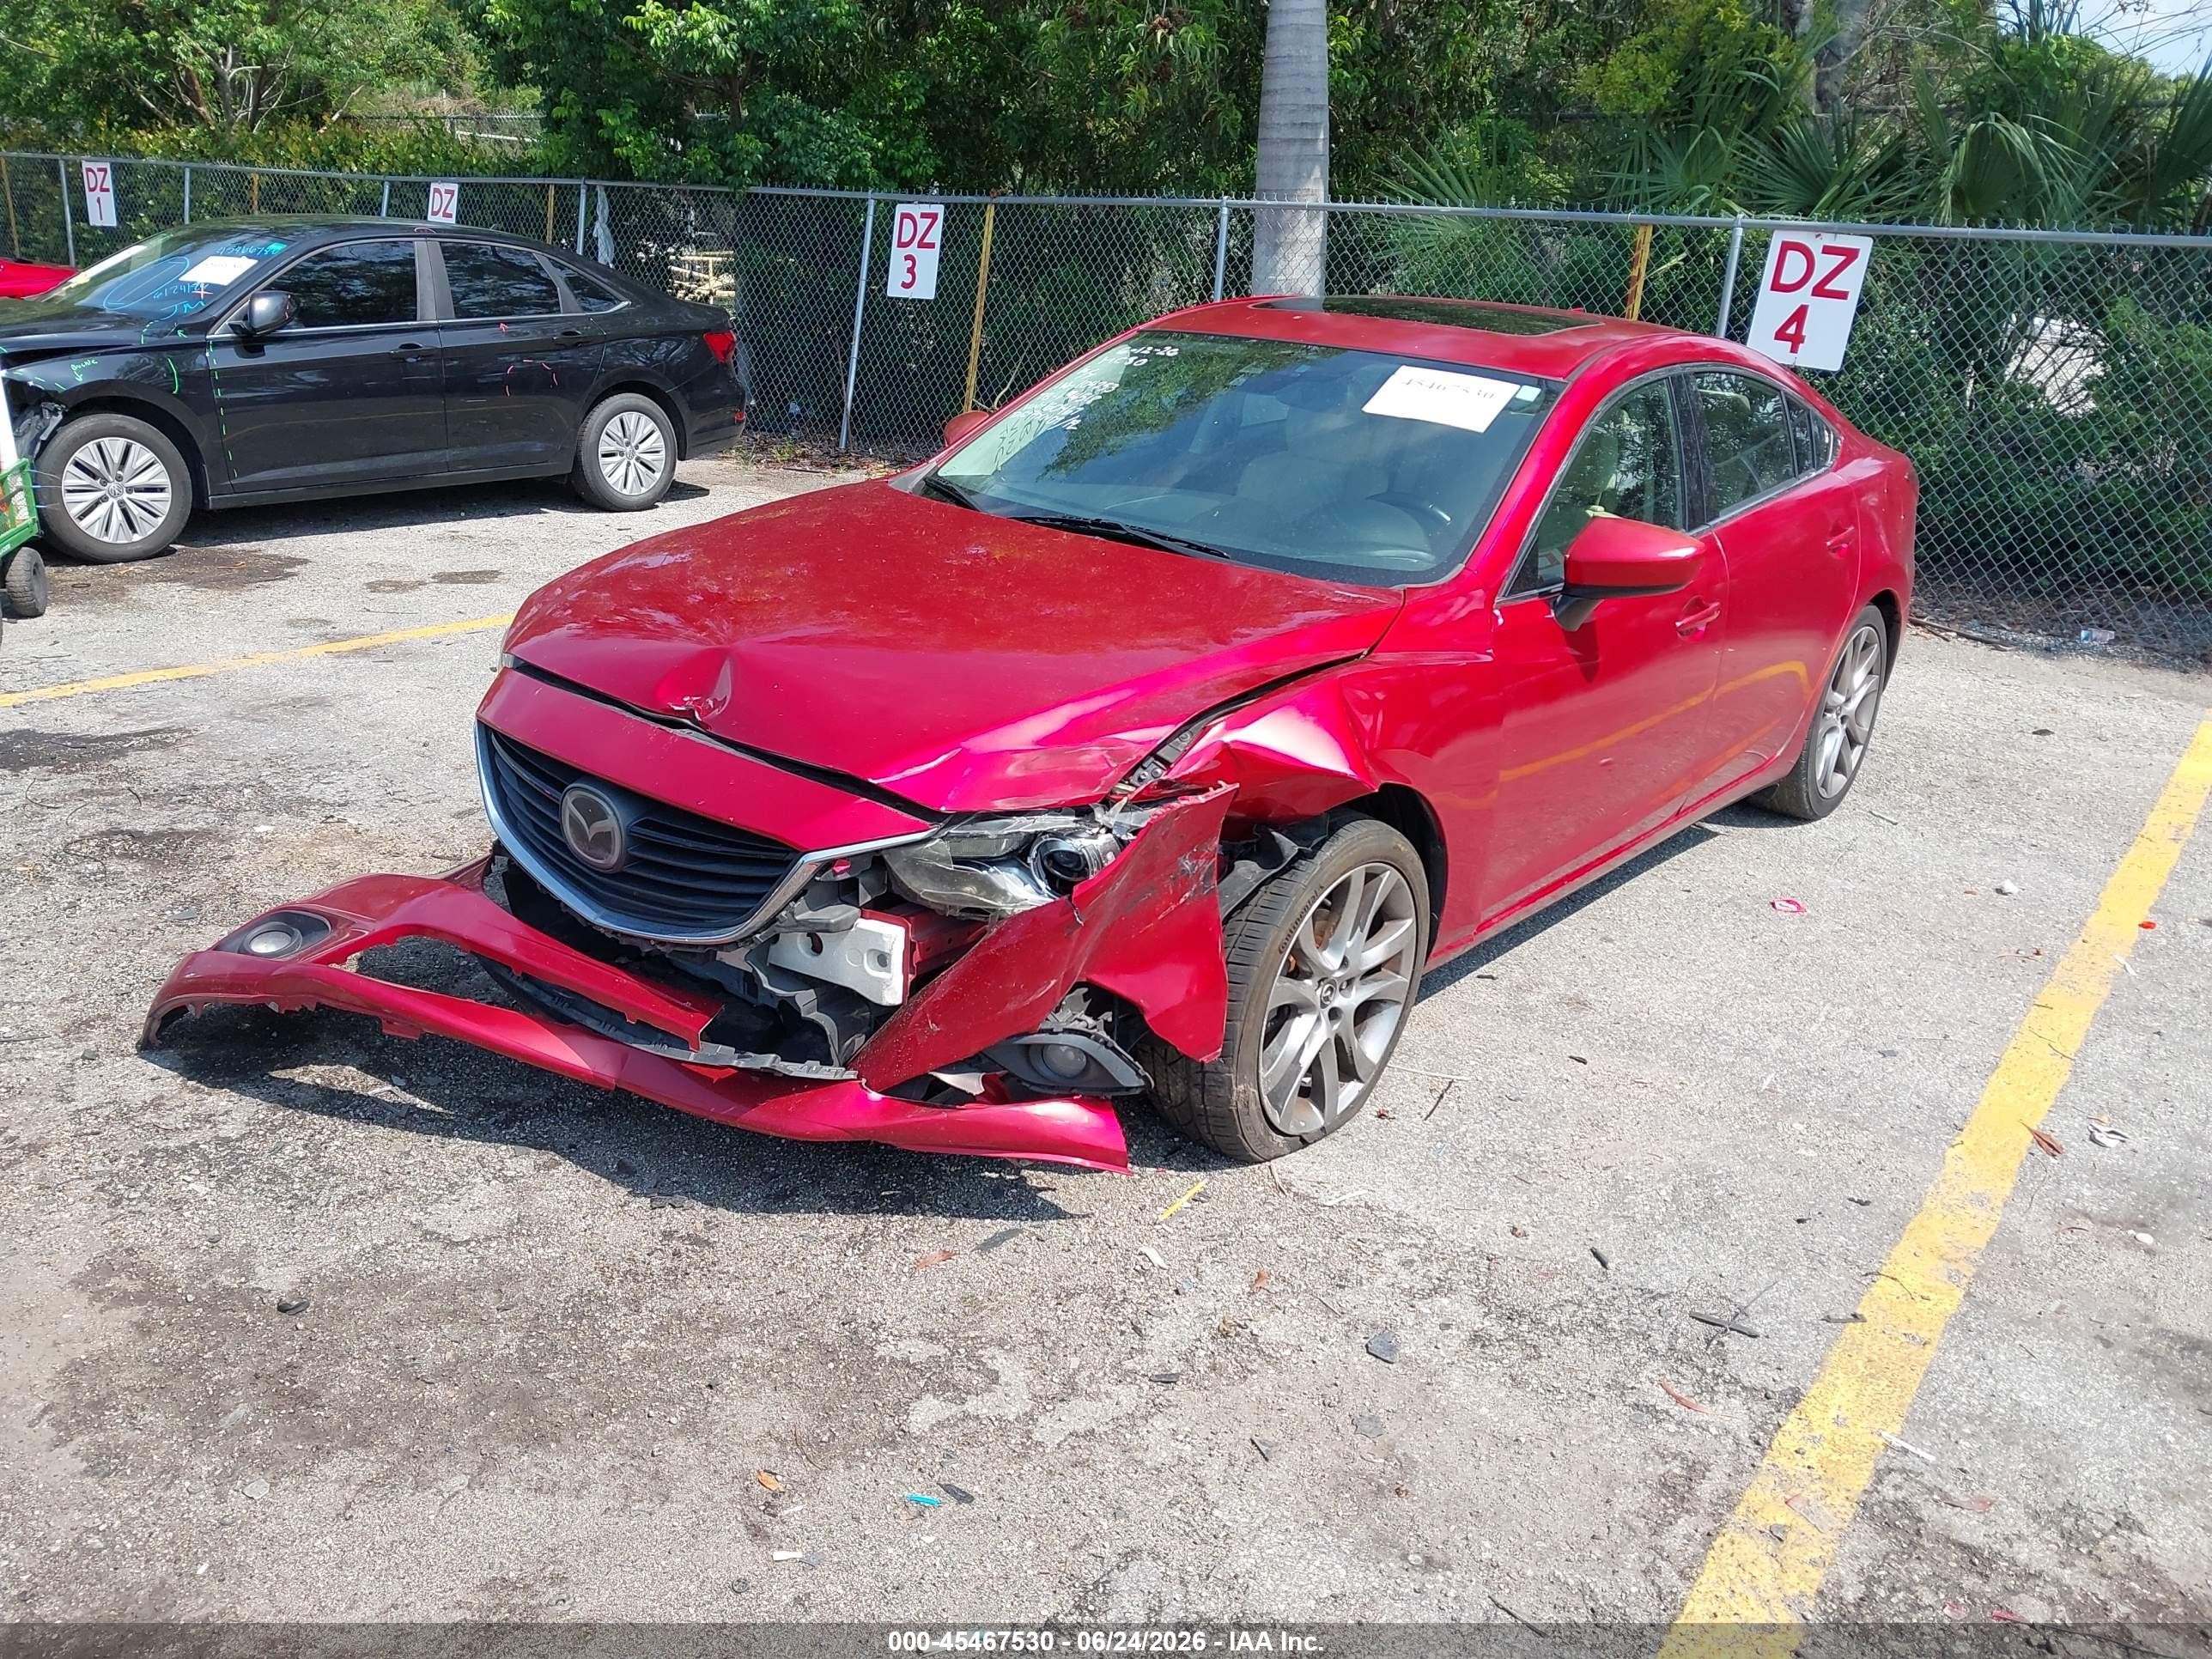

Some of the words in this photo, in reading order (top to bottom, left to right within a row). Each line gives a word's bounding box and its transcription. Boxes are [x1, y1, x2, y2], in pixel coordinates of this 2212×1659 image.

[85, 167, 110, 192] DZ
[97, 197, 103, 221] 1
[431, 187, 455, 218] DZ
[896, 212, 939, 249] DZ
[901, 254, 916, 289] 3
[1770, 240, 1860, 300] DZ
[1774, 304, 1809, 354] 4
